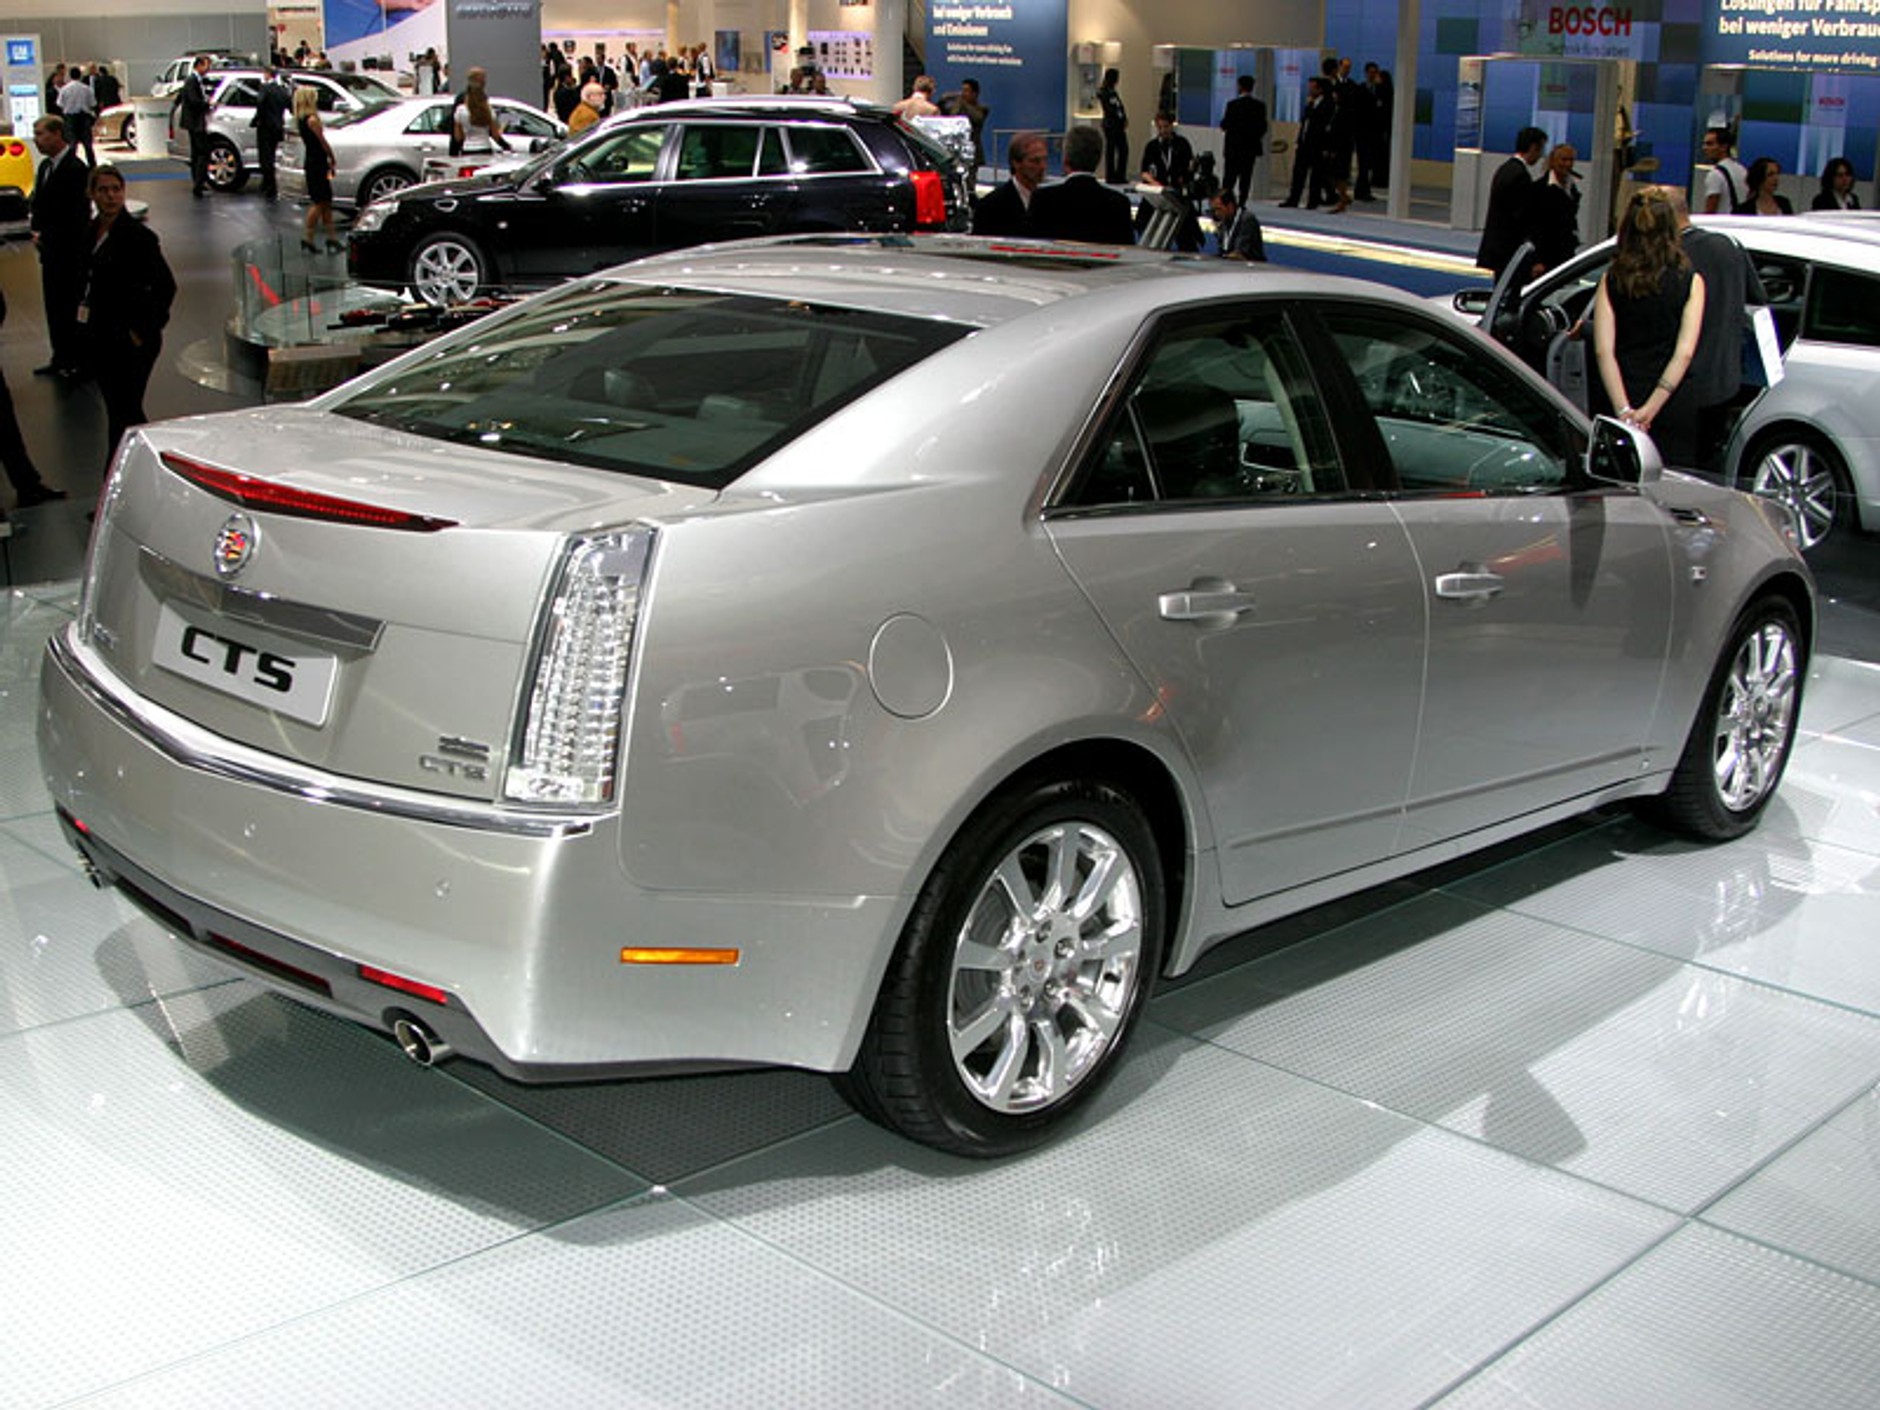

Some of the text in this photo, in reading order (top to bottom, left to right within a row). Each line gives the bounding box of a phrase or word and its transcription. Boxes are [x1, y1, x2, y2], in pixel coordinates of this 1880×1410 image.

[1547, 6, 1632, 36] BOSCH
[1718, 16, 1880, 39] bei weniger Verbrau
[1748, 49, 1794, 62] Solutions
[1796, 50, 1811, 63] for
[1812, 53, 1839, 63] more
[1840, 52, 1878, 68] driving
[181, 625, 296, 692] CTS
[419, 754, 487, 780] CTS
